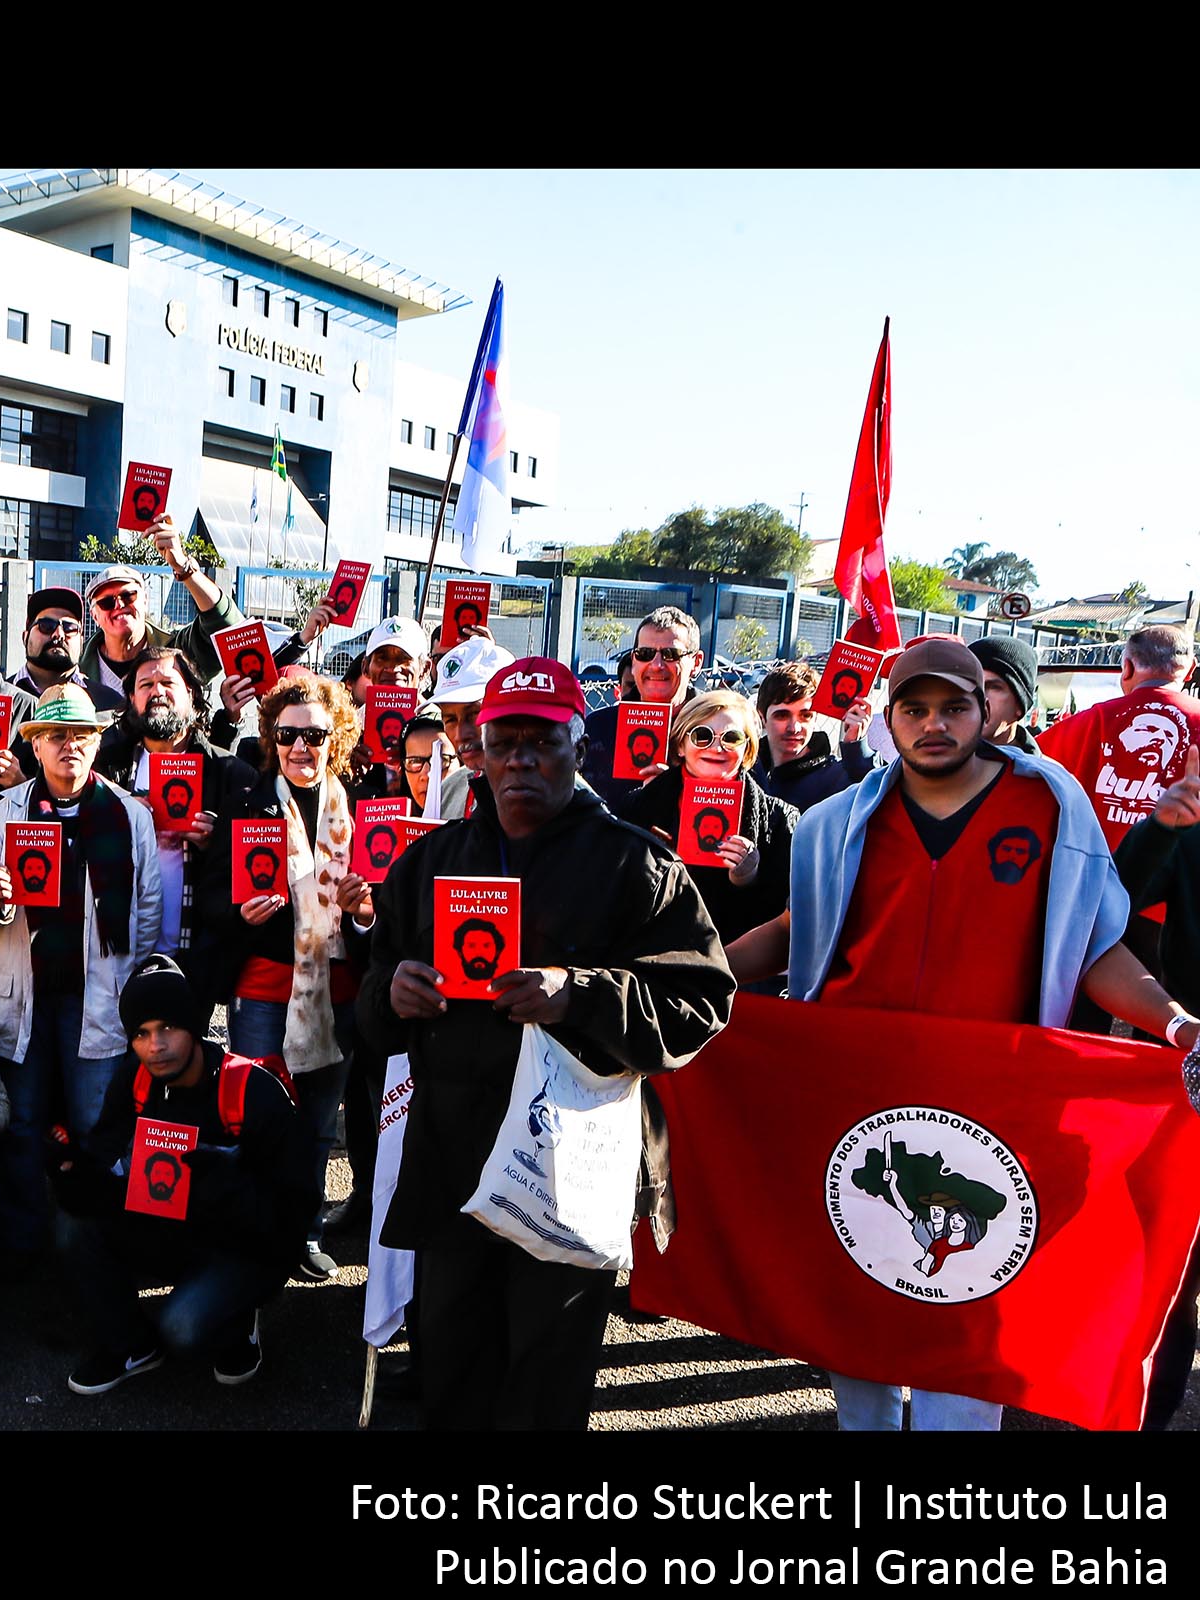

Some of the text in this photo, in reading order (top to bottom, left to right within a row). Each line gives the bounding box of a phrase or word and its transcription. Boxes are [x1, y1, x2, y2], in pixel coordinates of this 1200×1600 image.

[272, 341, 325, 376] FEDERAL
[135, 467, 166, 477] LULALIVRE
[133, 476, 164, 486] LULALIVRO
[226, 629, 258, 642] LULALIVRE
[227, 638, 260, 650] LULALIVRO
[841, 649, 875, 663] LULALIVRE
[837, 657, 871, 672] LULALIVRO
[628, 709, 663, 717] LULALIVRE
[627, 718, 662, 726] LULALIVRO
[695, 786, 734, 795] LULALIVRE
[694, 796, 733, 805] LULALIVRO
[365, 804, 400, 812] LULALIVRE
[1107, 806, 1147, 825] Livre
[242, 835, 280, 843] LULALIVRO
[450, 889, 508, 900] LULALIVRE
[450, 904, 508, 914] LULALIVRO
[147, 1127, 188, 1140] LULALIVRE
[145, 1139, 187, 1152] LULALIVRO
[503, 1166, 559, 1213] ÁGUA É DIREIT
[828, 1109, 1033, 1283] MOVIMENTO DOS TRABALHADORES RURAIS SEM TERRA
[894, 1277, 949, 1299] BRASIL
